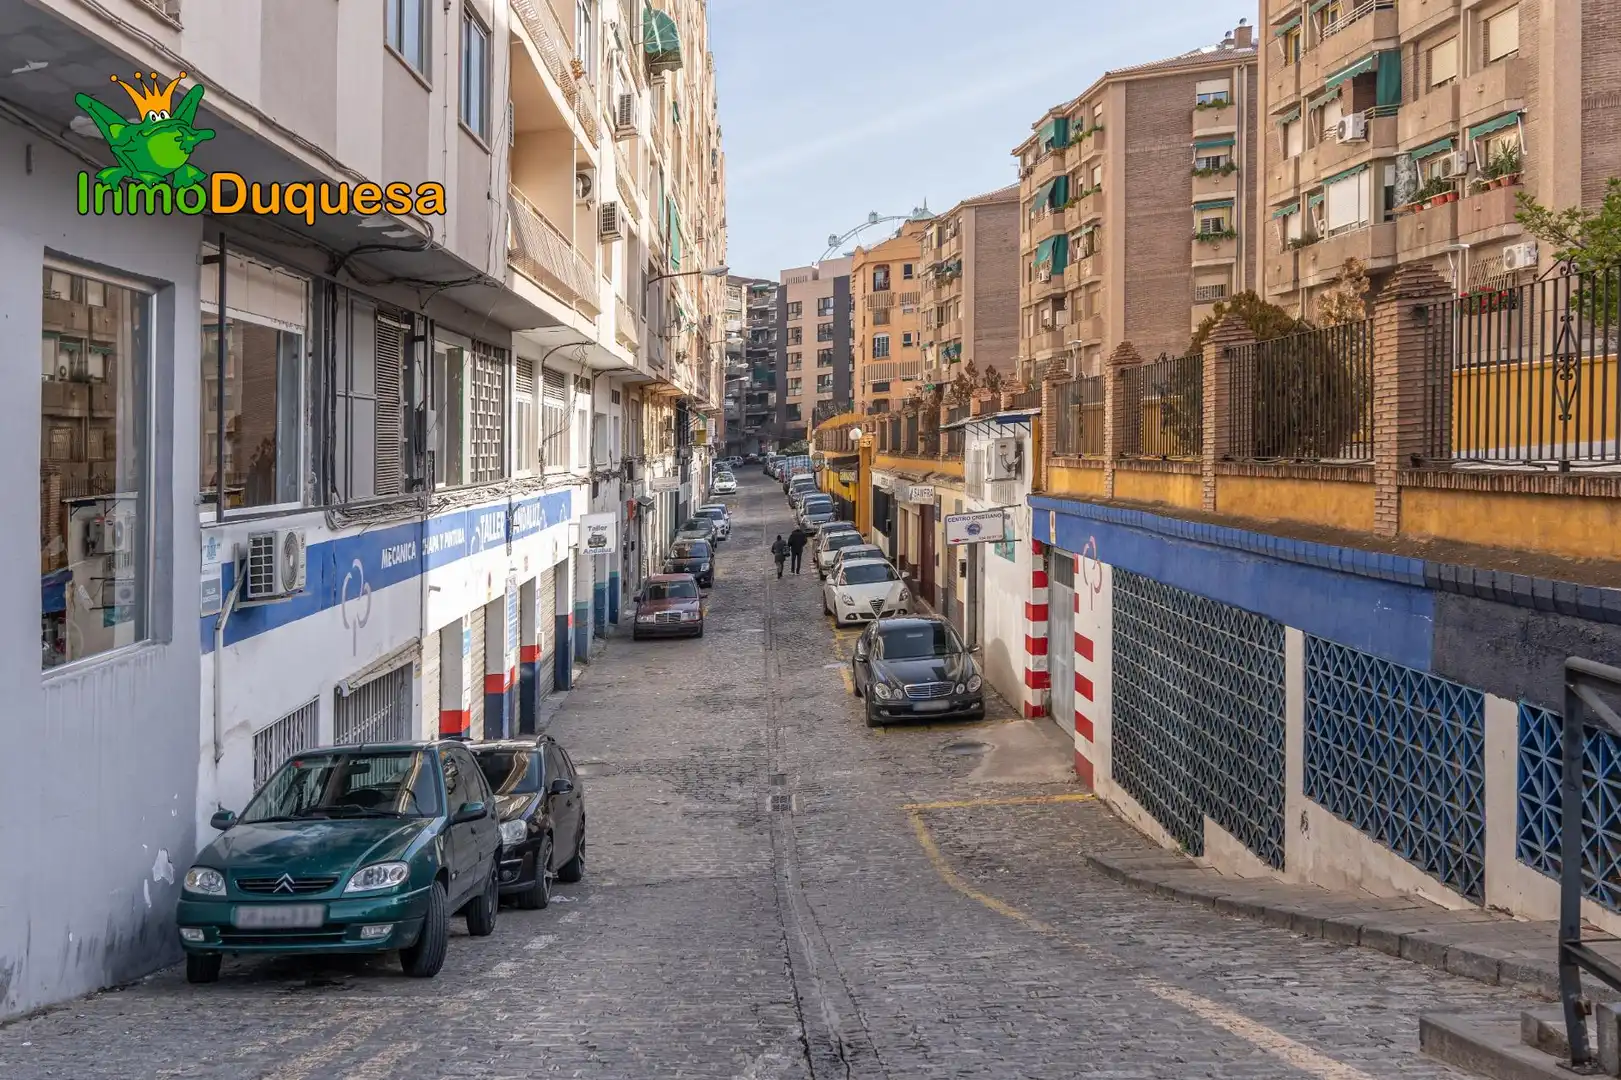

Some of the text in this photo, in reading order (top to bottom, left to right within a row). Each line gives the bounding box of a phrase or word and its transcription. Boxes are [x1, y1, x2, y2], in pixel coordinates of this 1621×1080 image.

[480, 502, 541, 543] TALLER ANDALUZ
[971, 512, 1002, 521] CRISTIANO
[381, 540, 417, 569] MECANICA
[445, 527, 465, 549] PINTURA
[582, 547, 612, 555] Andaluz
